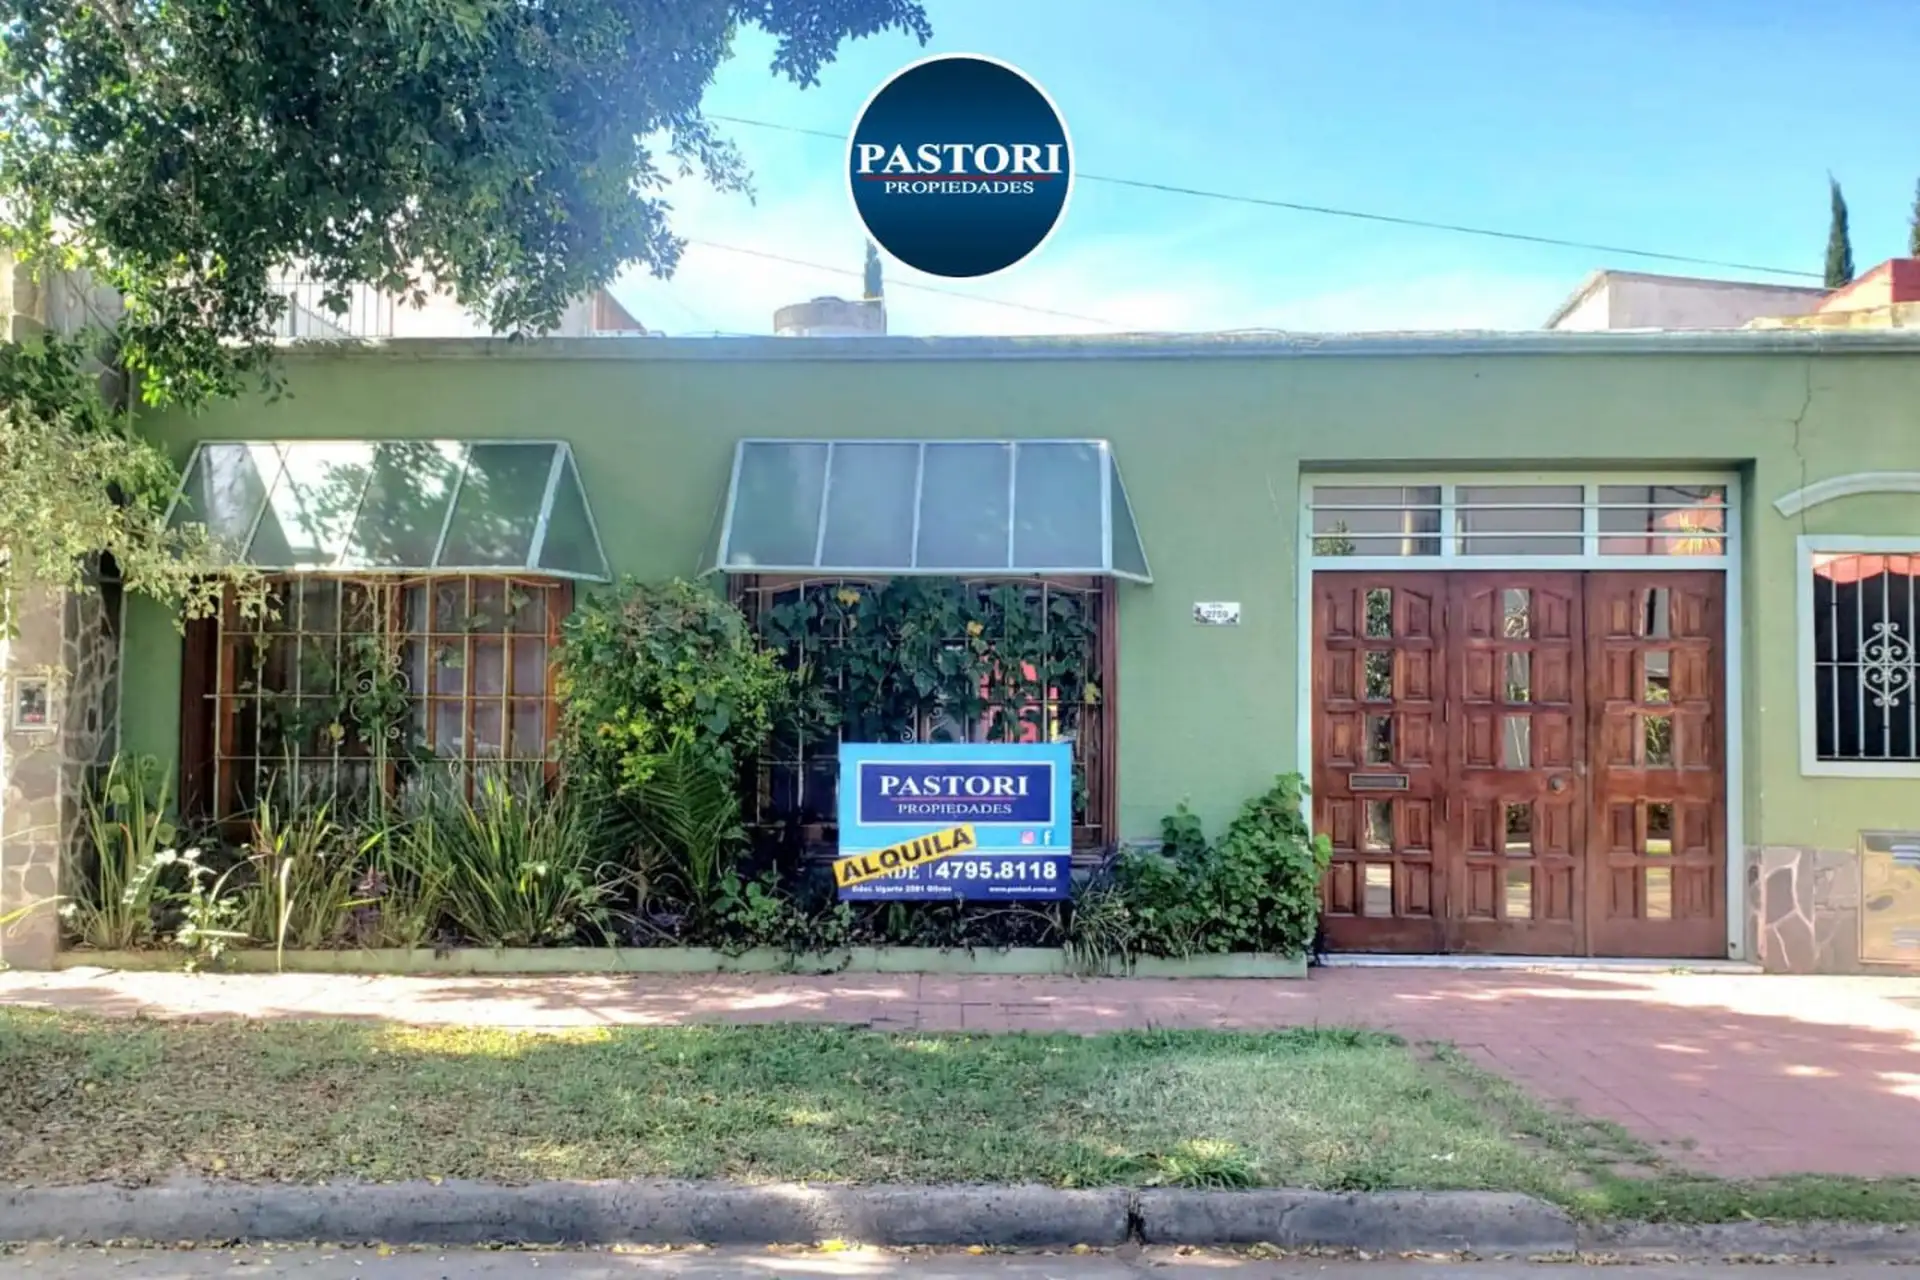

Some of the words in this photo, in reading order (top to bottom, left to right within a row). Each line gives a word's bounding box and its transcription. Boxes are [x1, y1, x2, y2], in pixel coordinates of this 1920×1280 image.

[879, 775, 1029, 796] PASTORI
[898, 803, 1013, 815] PROPIEDADES
[841, 827, 972, 882] ALQUILA
[935, 861, 1057, 880] 4795.8118
